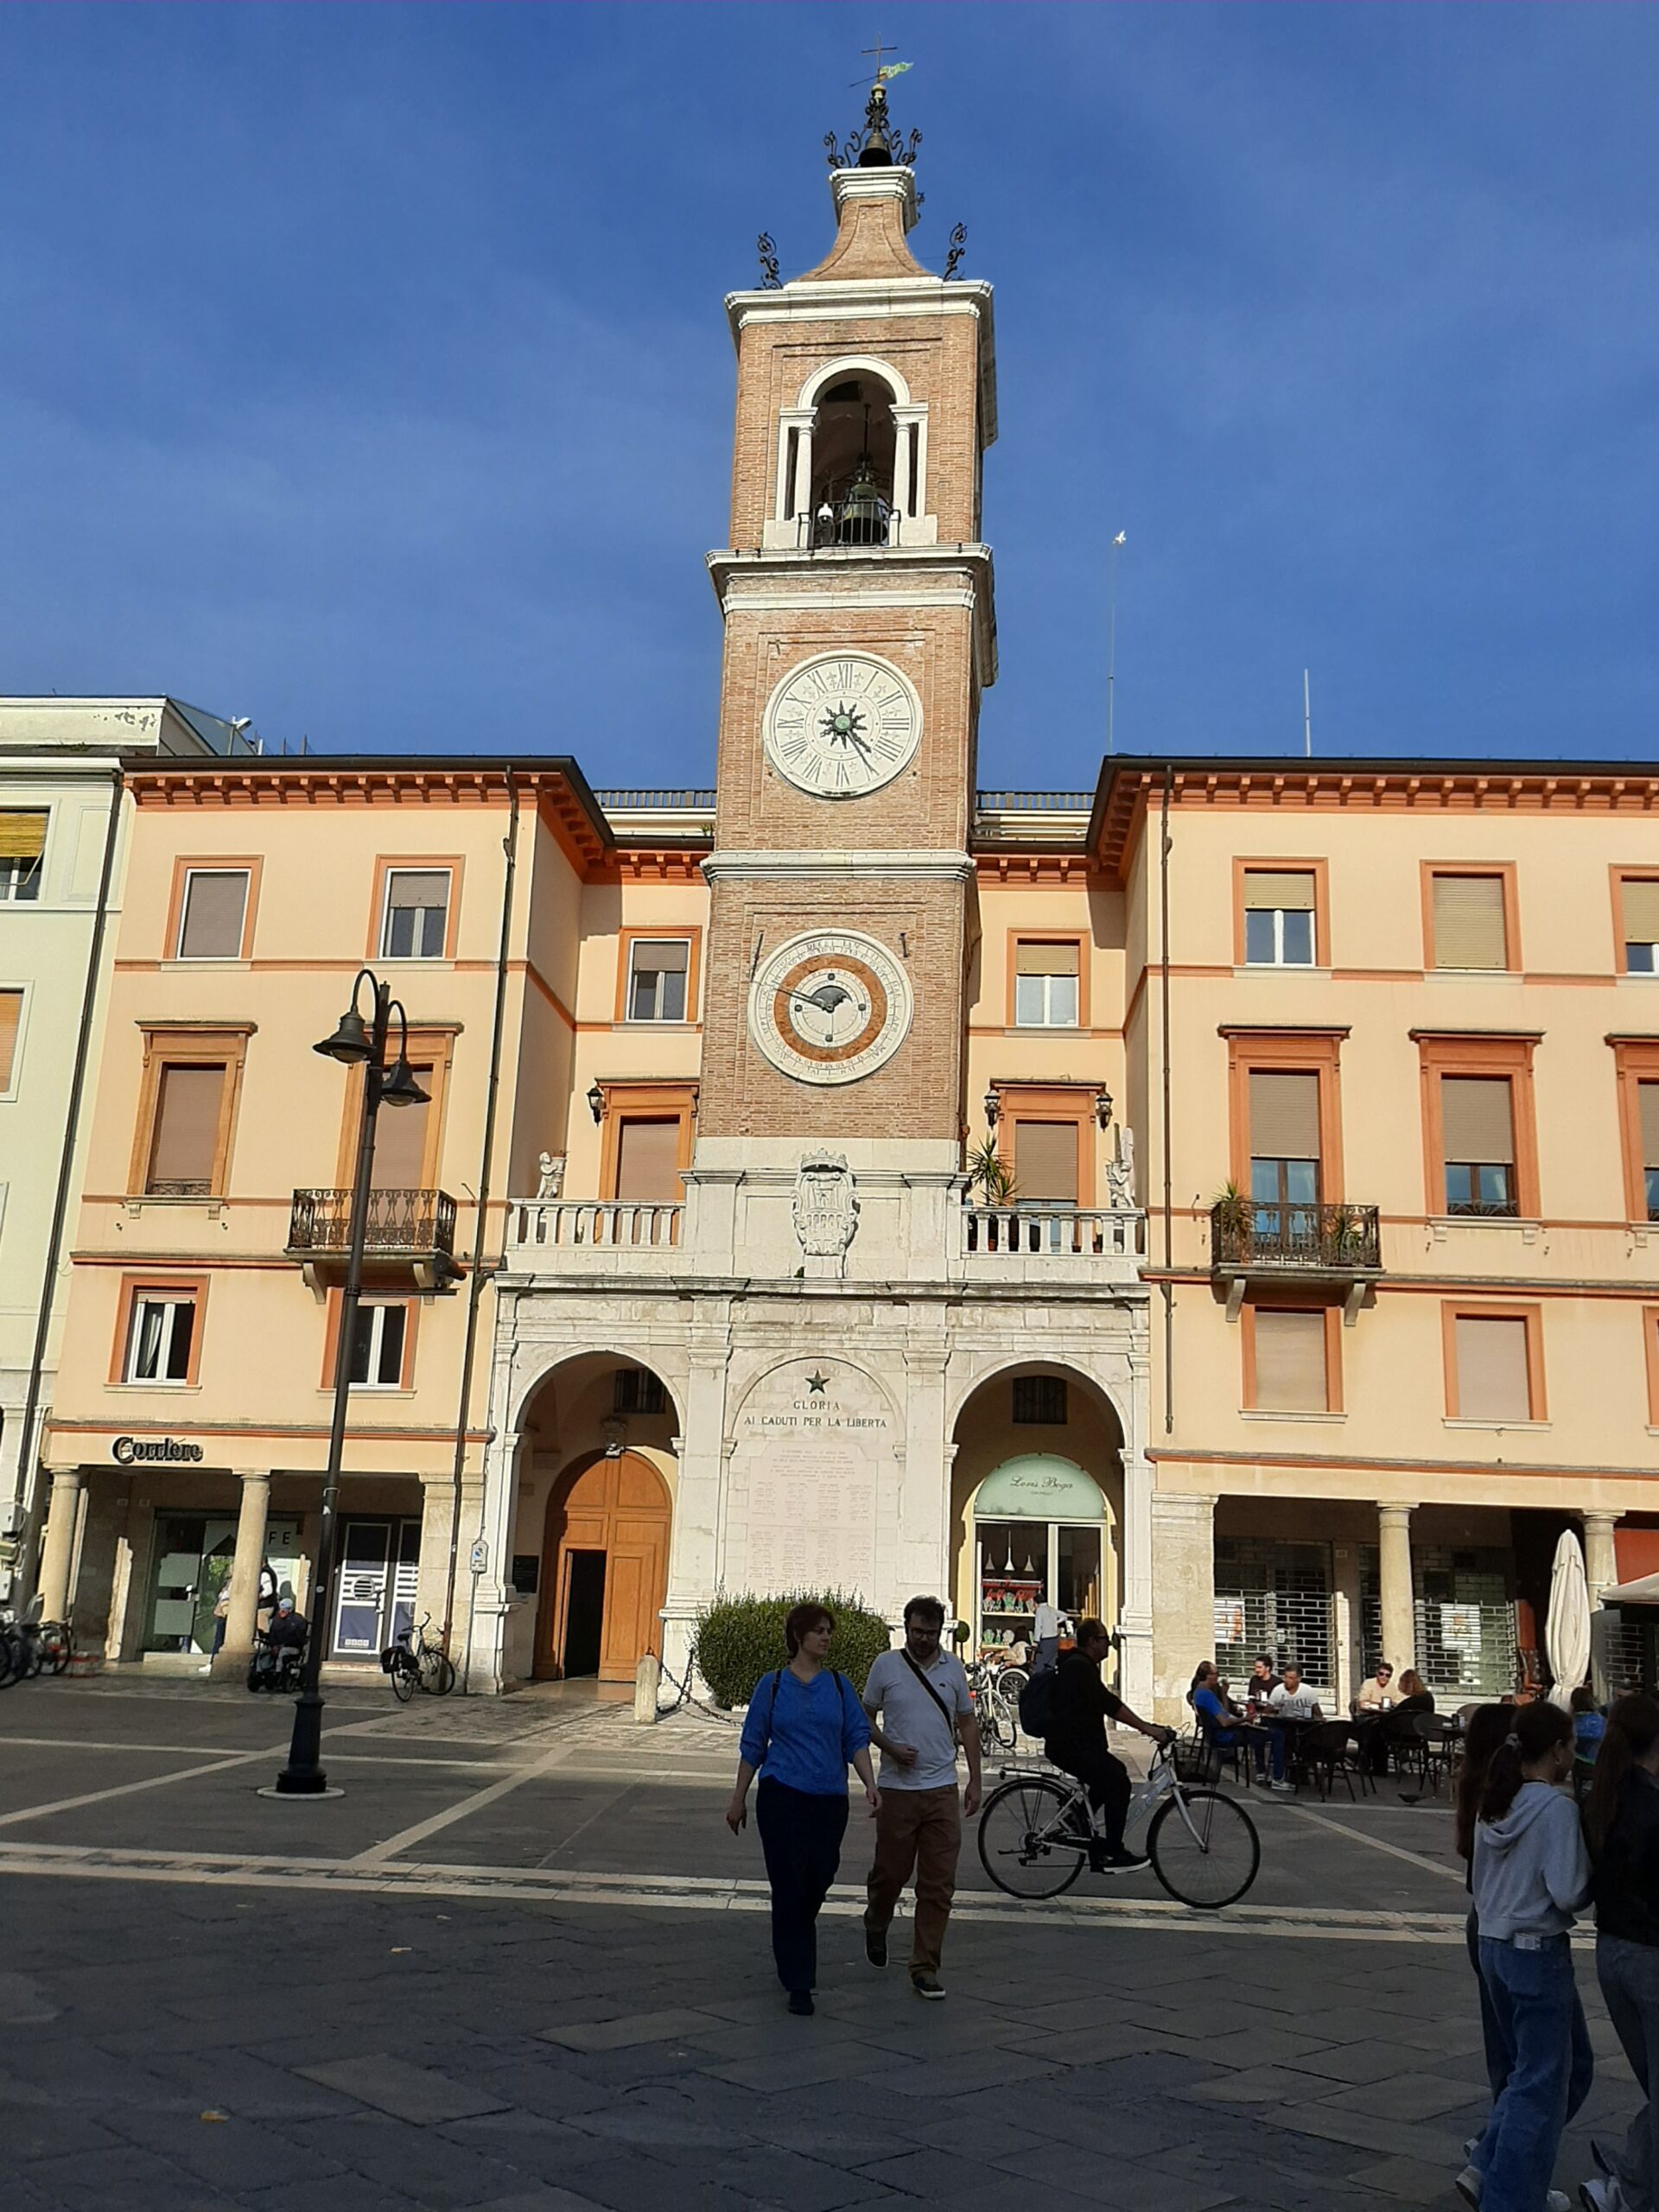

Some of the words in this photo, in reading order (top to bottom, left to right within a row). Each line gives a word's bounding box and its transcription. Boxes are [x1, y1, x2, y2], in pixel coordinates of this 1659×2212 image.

[806, 670, 829, 698] XI
[836, 663, 854, 690] XII
[785, 691, 812, 711] X
[877, 690, 905, 709] II
[881, 717, 910, 731] III
[793, 1400, 841, 1411] GLORIA
[744, 1415, 755, 1425] AI
[761, 1416, 798, 1426] CADUTI
[804, 1417, 822, 1427] PER
[828, 1418, 841, 1427] LA
